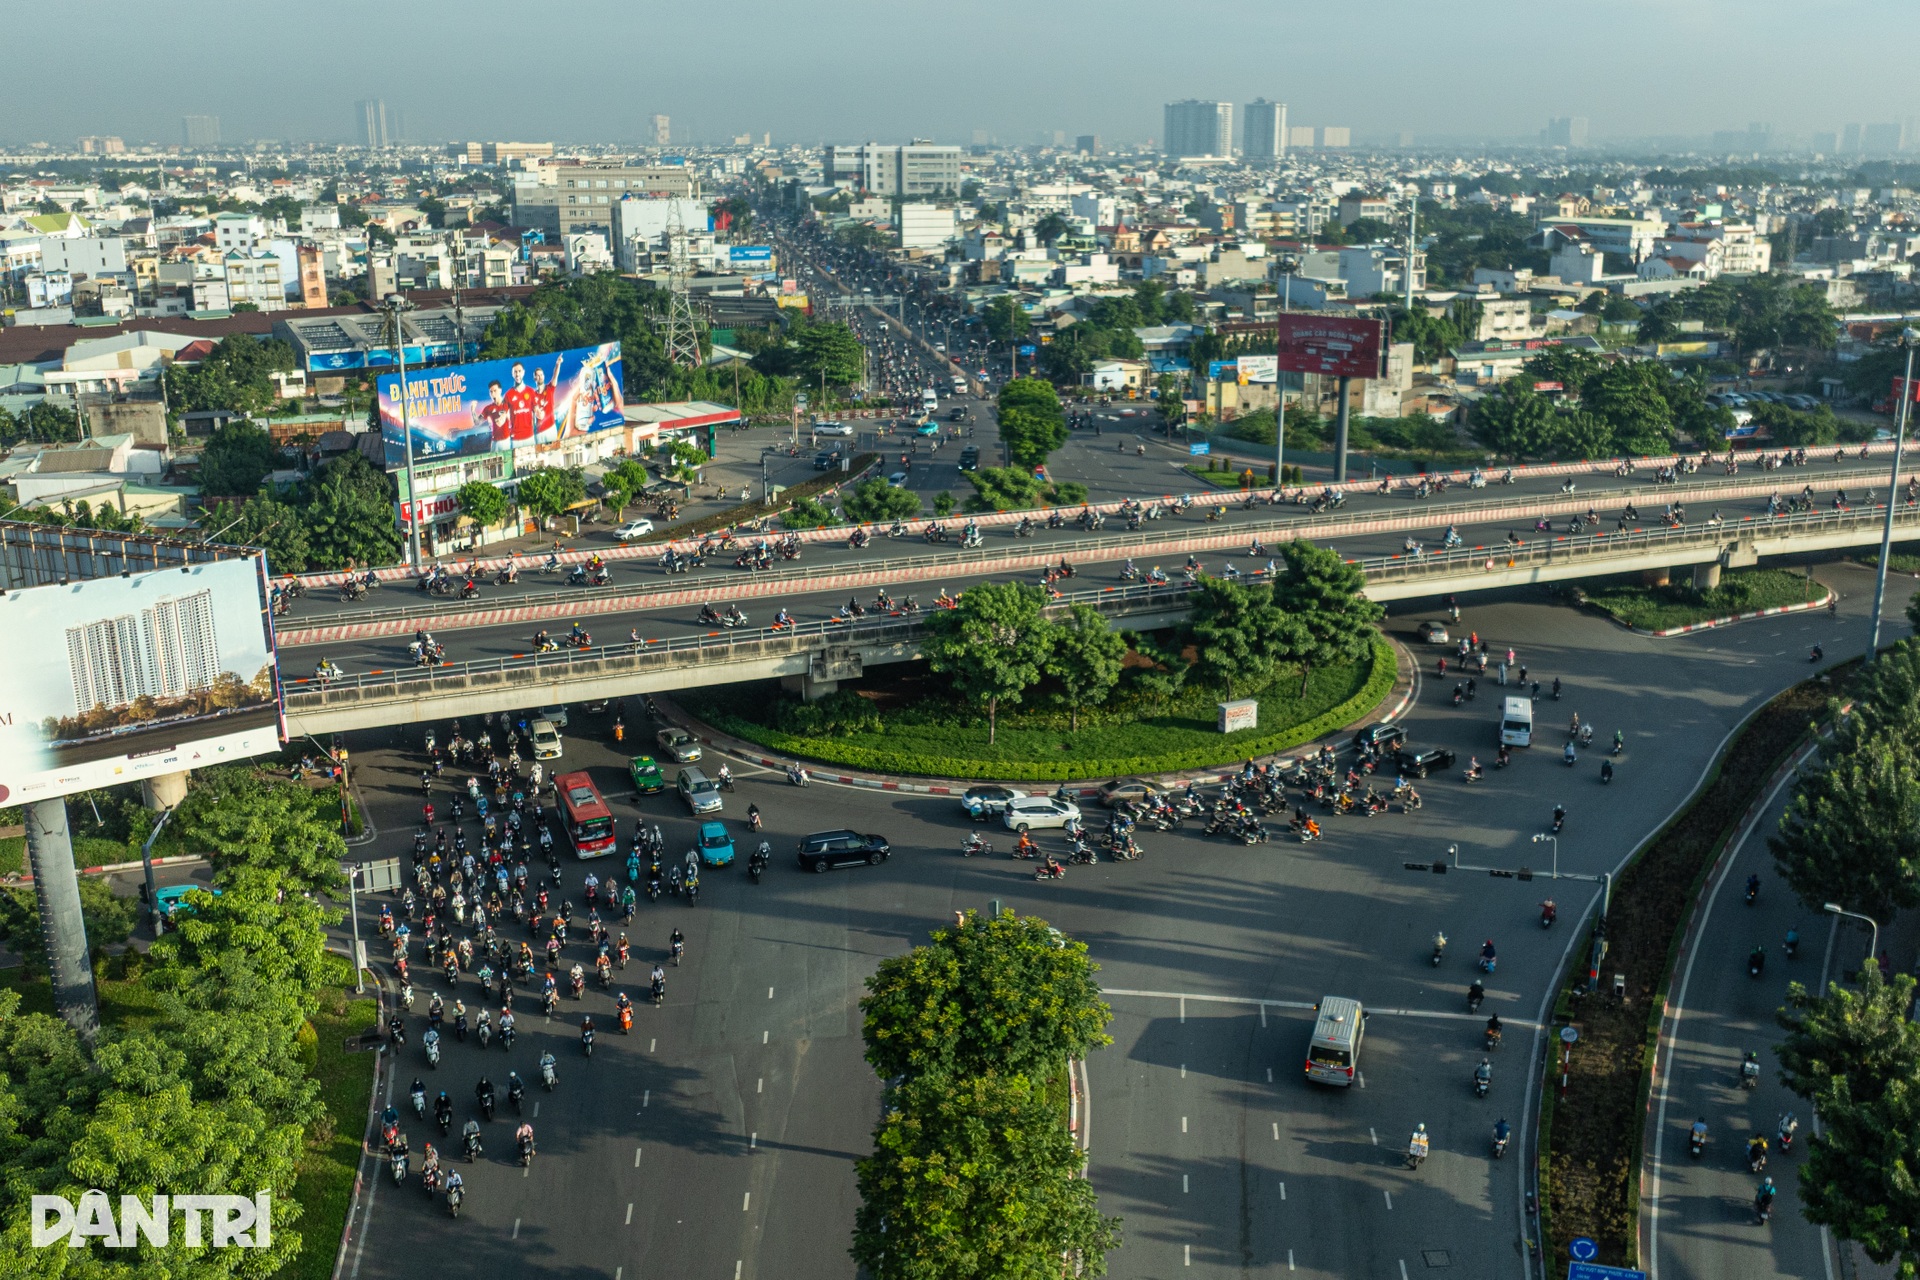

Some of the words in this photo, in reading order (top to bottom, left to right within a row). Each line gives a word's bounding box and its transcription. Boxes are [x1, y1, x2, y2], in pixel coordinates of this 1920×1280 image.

[430, 372, 467, 397] THỨC
[430, 394, 462, 416] LĨNH
[163, 756, 178, 764] OTIS
